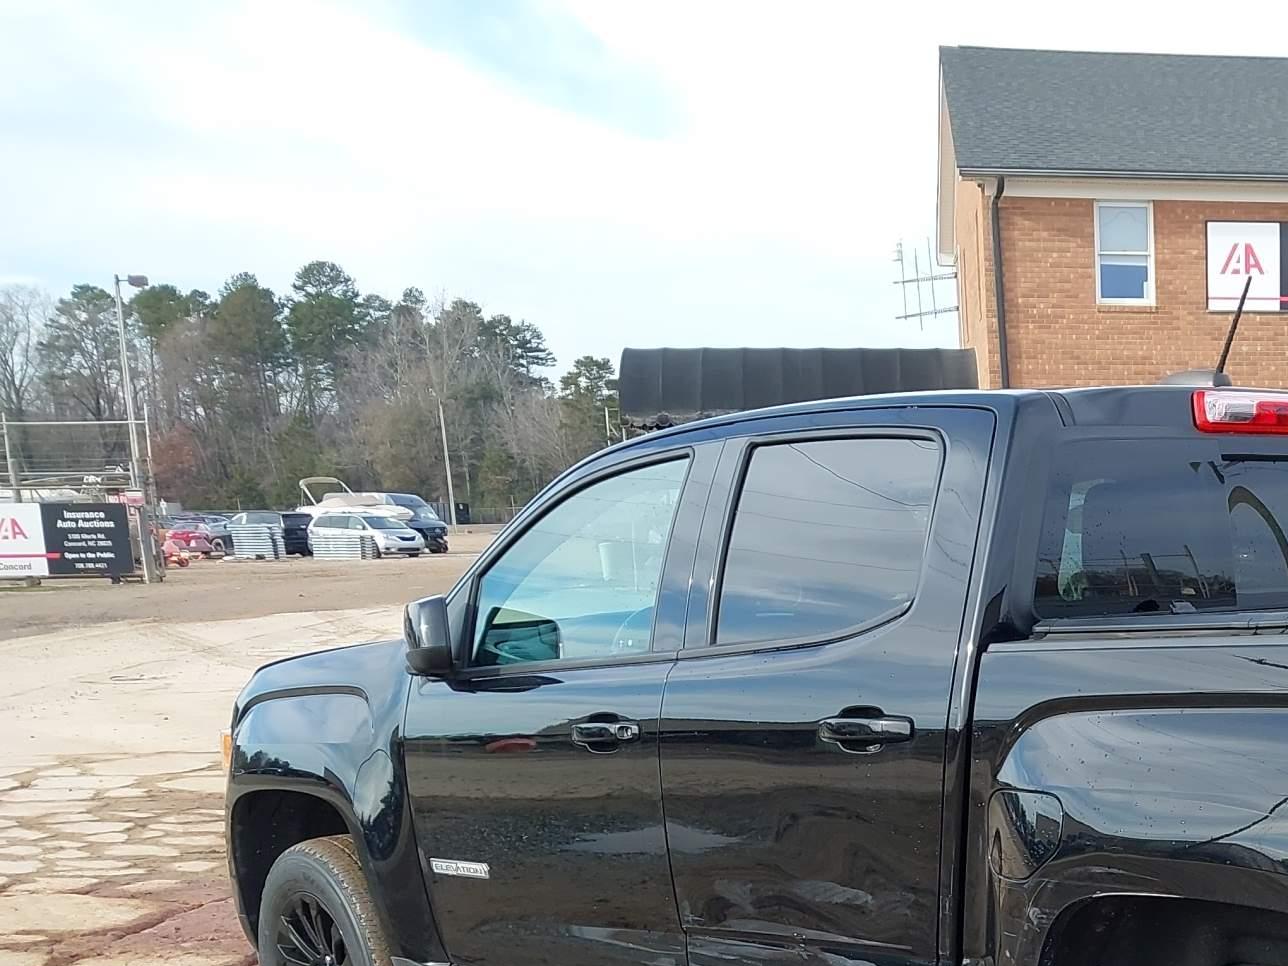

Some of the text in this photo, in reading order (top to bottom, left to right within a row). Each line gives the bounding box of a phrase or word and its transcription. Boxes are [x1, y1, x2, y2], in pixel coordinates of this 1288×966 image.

[63, 510, 105, 519] Insurance
[57, 519, 115, 528] Auto Auctions
[64, 552, 80, 560] Open
[434, 863, 483, 874] ELEVATION
